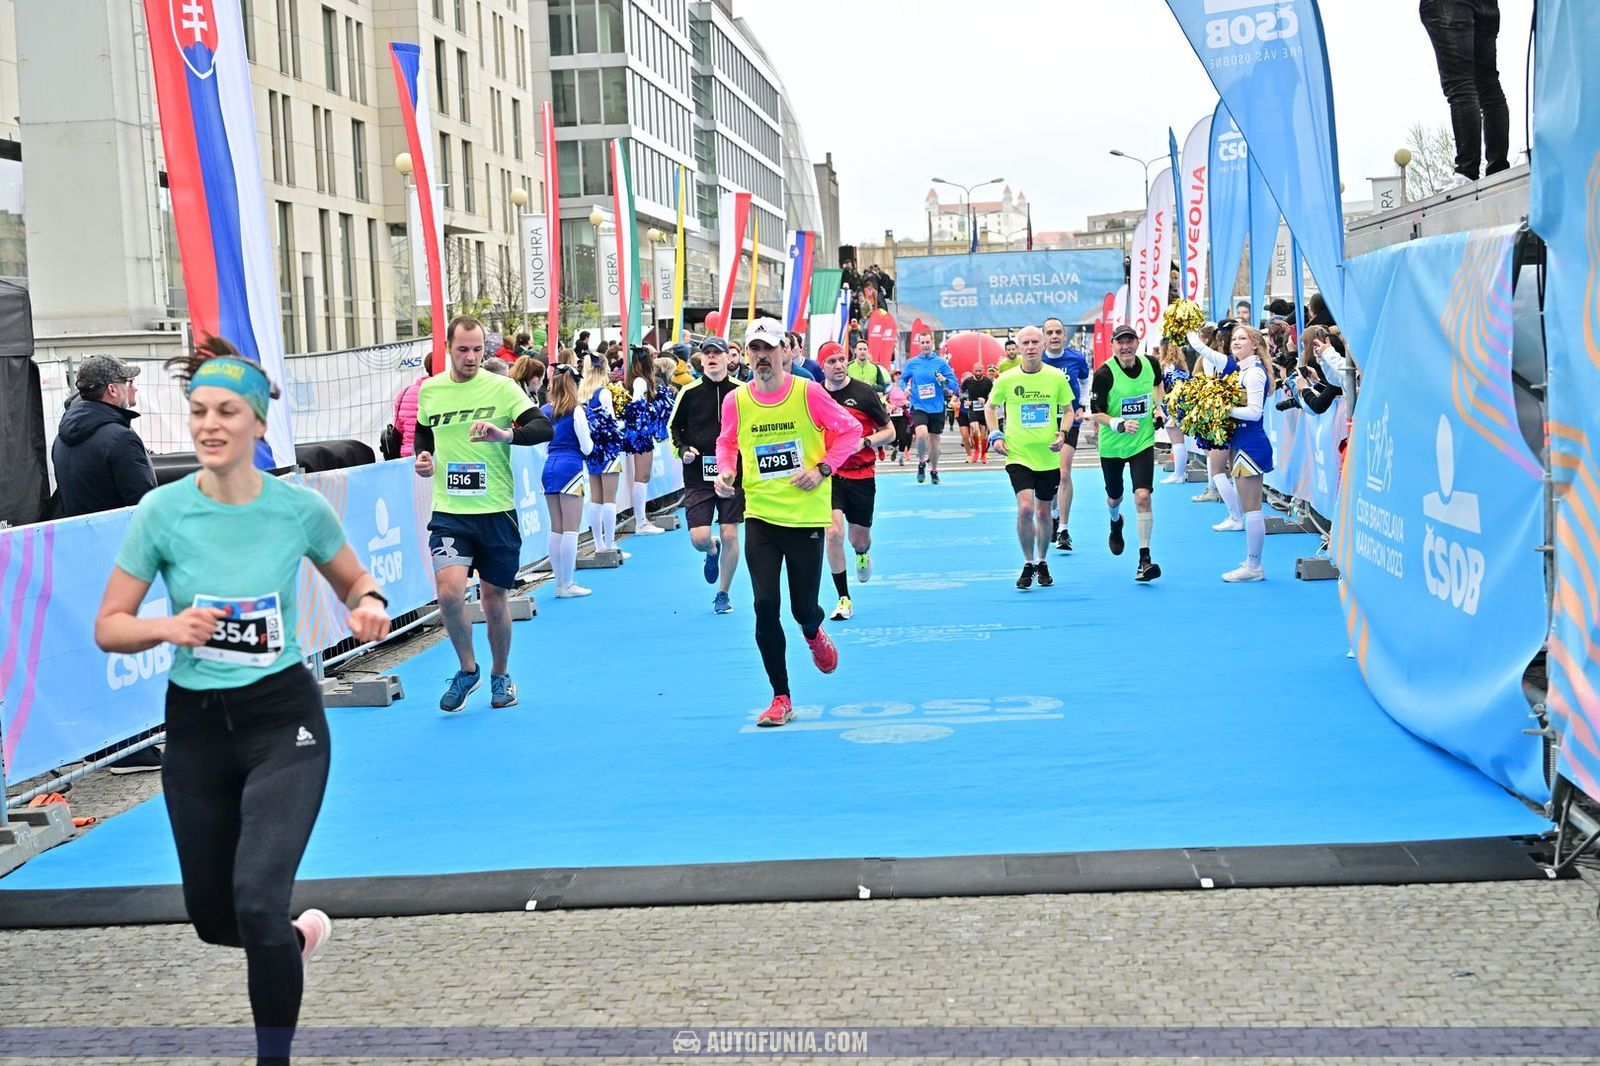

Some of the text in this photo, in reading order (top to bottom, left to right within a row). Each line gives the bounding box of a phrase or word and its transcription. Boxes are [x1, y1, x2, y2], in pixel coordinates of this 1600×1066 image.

[1218, 142, 1248, 161] ČSO
[1381, 189, 1393, 209] RA
[1187, 165, 1207, 262] VEOLIA
[1151, 210, 1164, 290] VEOLIA
[1276, 243, 1287, 277] BALET
[530, 226, 547, 299] ČINOHRA
[607, 252, 620, 296] OPERA
[661, 266, 673, 300] BALET
[988, 273, 1081, 288] BRATISLAVA
[1138, 248, 1148, 314] VEOLIA
[989, 291, 1078, 306] MARATHON
[399, 356, 422, 368] AKS
[428, 405, 496, 428] OTTO
[1021, 411, 1036, 420] 215
[1122, 403, 1141, 412] 4531
[759, 421, 795, 433] AUTOFUNIA
[759, 455, 788, 469] 4798
[448, 474, 471, 485] 1516
[1423, 522, 1485, 617] ČSOB
[211, 620, 260, 647] 354
